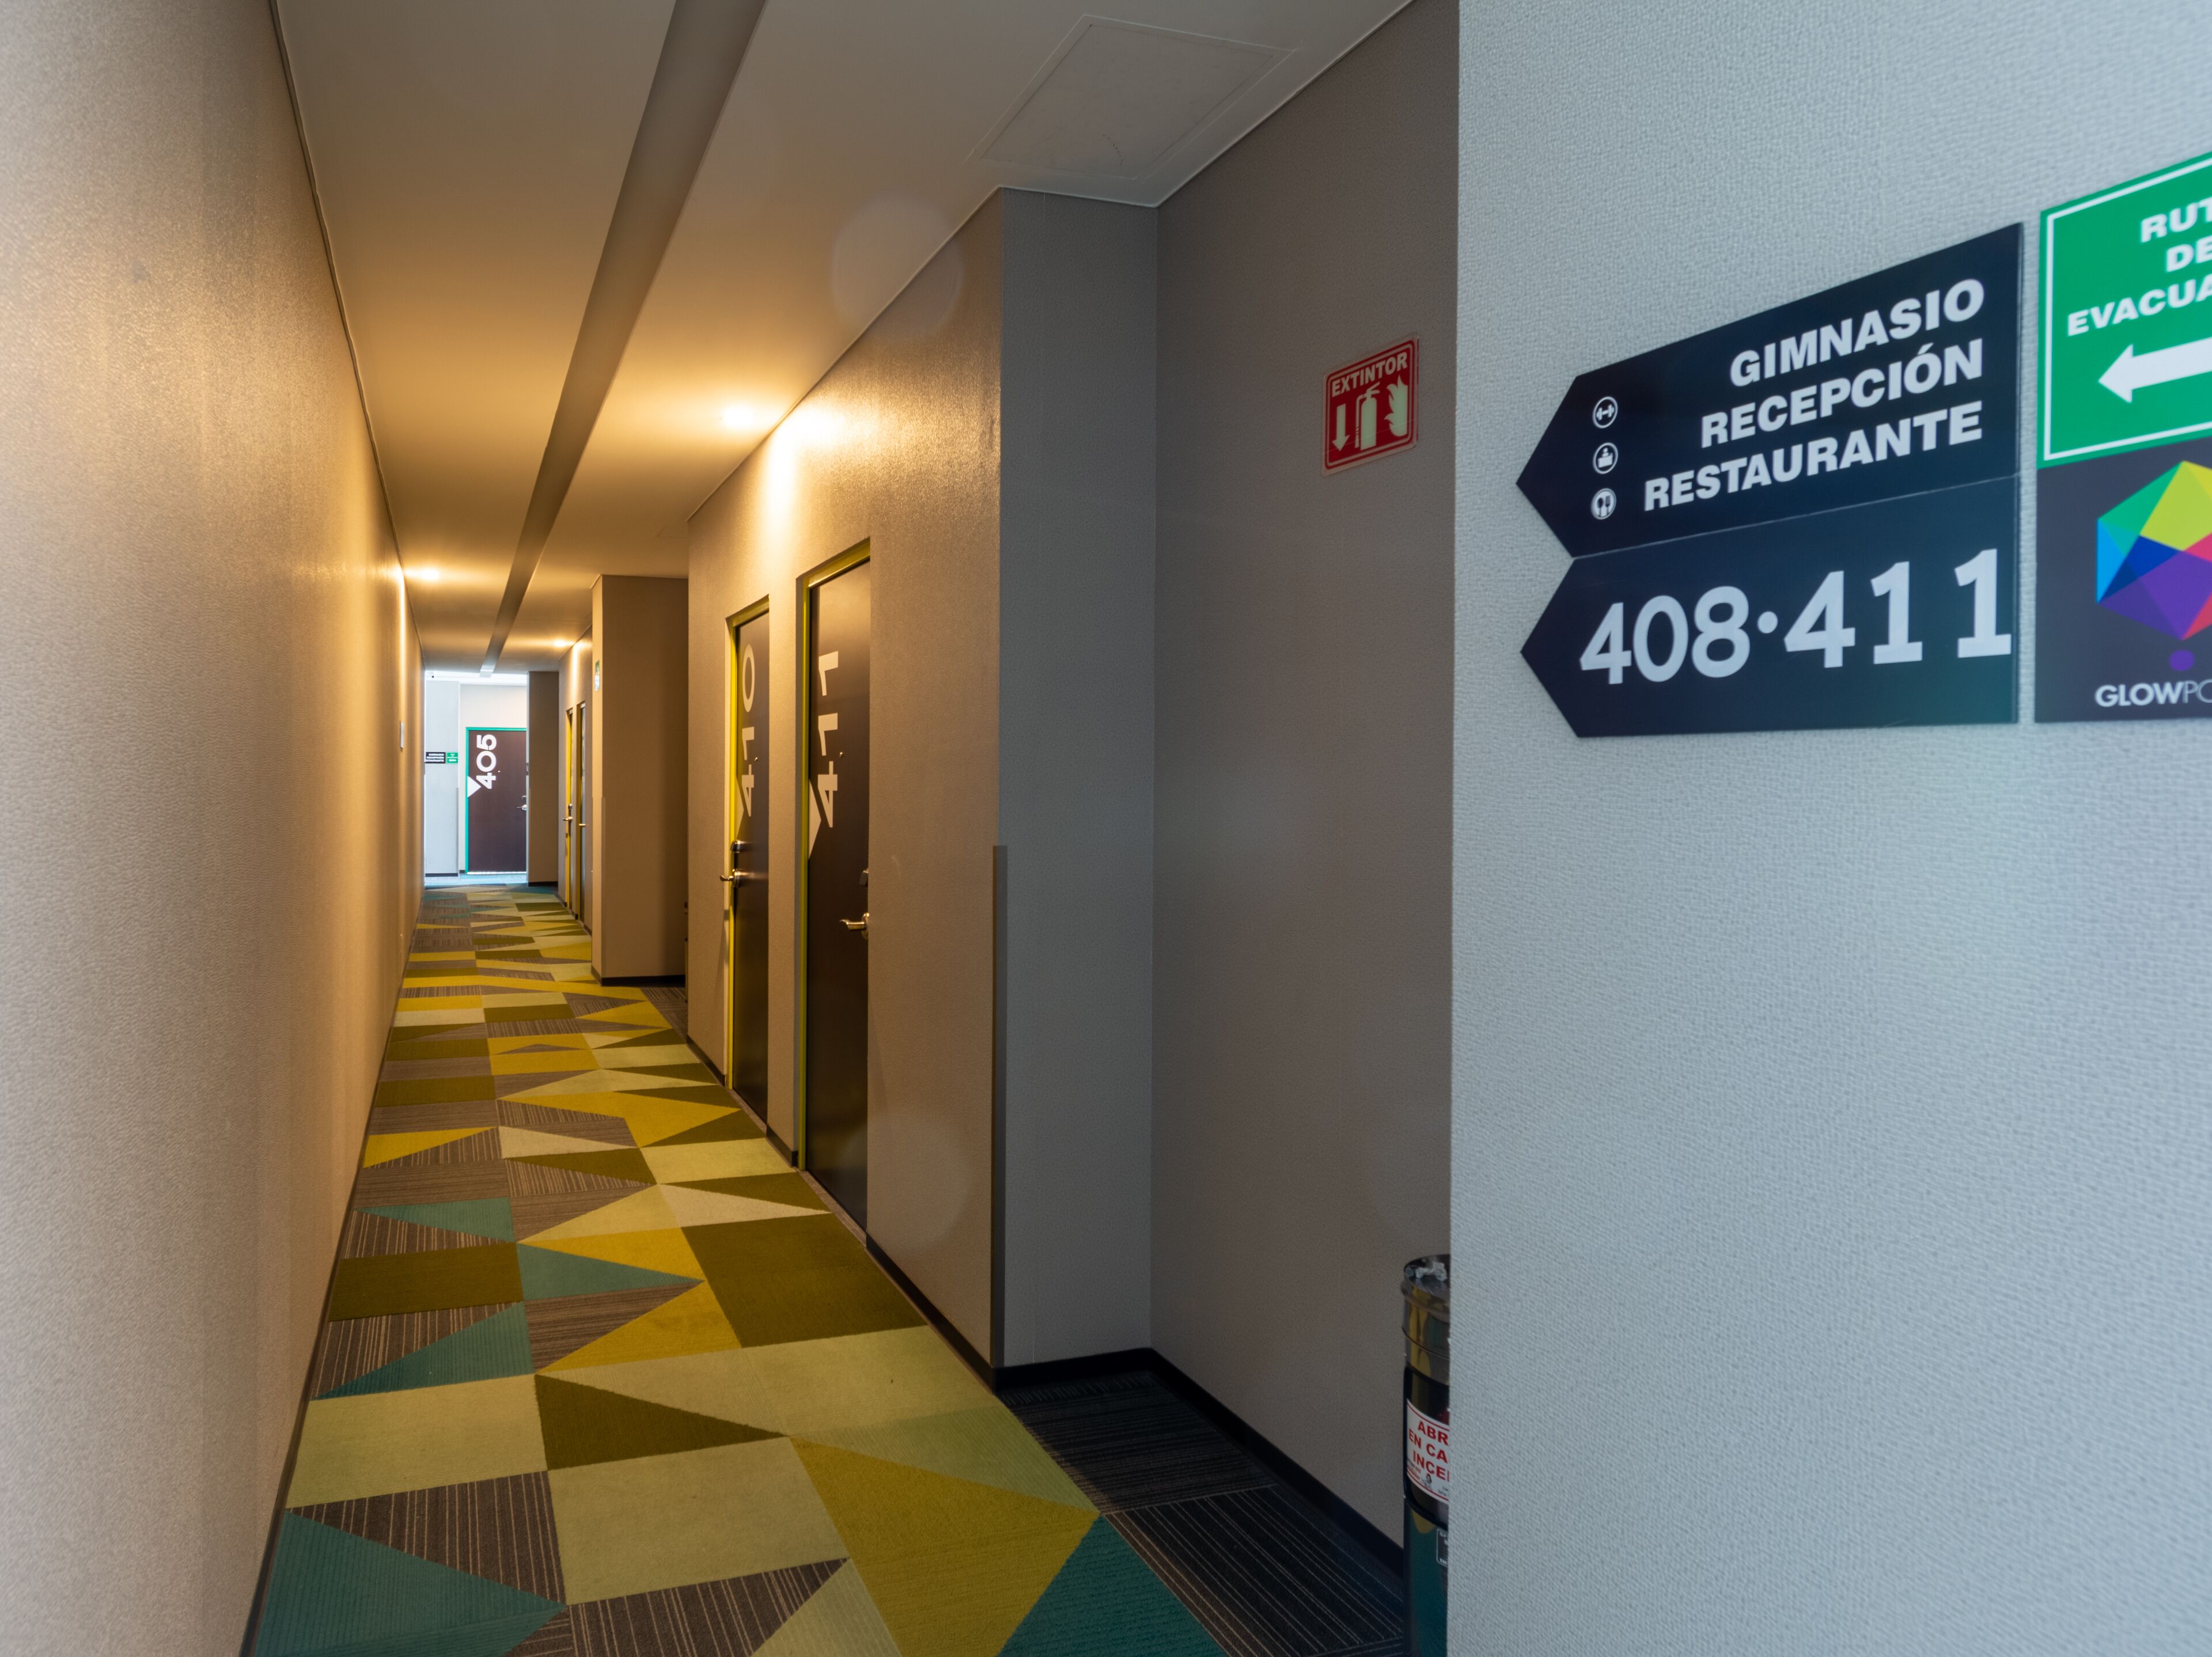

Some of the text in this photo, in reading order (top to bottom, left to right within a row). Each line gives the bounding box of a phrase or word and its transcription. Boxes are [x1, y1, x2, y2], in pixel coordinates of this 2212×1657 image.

[2166, 235, 2212, 272] DE
[1730, 278, 1985, 386] GIMNASIO
[1332, 351, 1408, 397] EXTINTOR
[1700, 338, 1984, 448] RECEPCIÓN
[1643, 401, 1983, 511] RESTAURANTE
[741, 644, 755, 817] 410
[817, 651, 839, 828] 411
[476, 734, 497, 790] 405
[1408, 1428, 1422, 1449] EN
[1418, 1420, 1449, 1447] ABR
[1413, 1450, 1450, 1482] INCE
